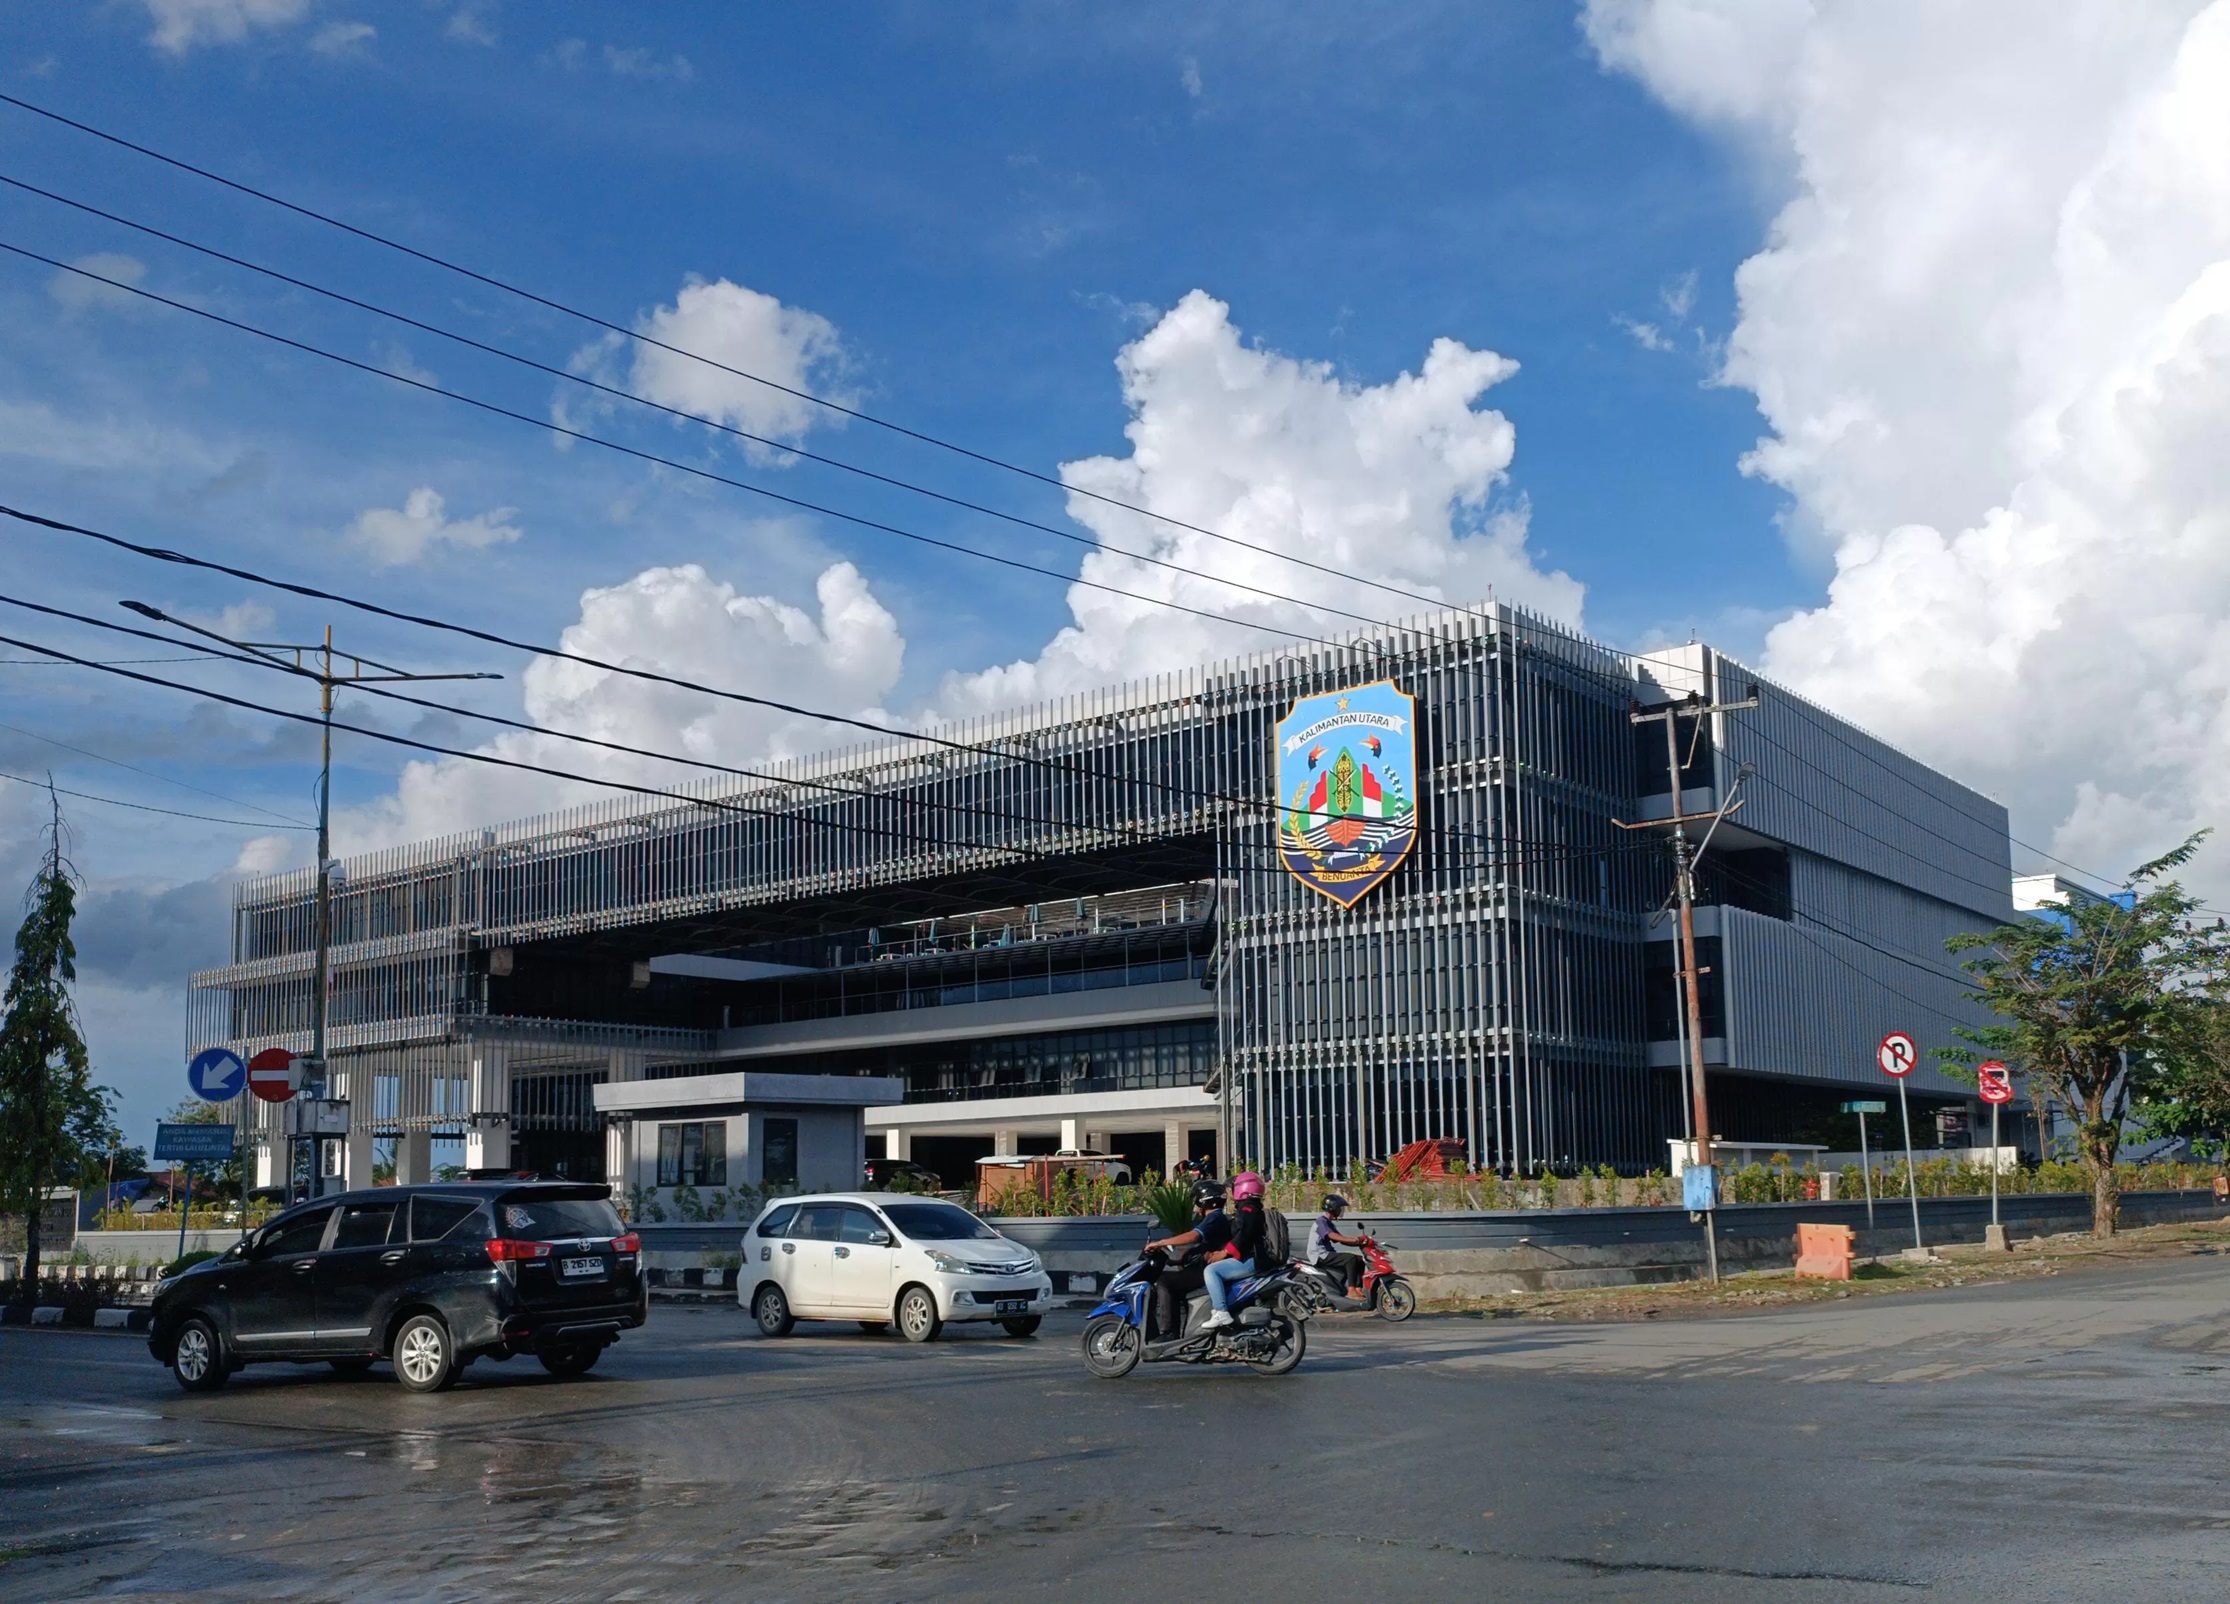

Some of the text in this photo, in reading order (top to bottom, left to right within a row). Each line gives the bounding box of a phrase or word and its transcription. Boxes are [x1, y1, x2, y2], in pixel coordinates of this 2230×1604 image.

[1299, 713, 1389, 744] KALIMANTAN UTARA
[158, 1144, 184, 1152] TERTIB
[562, 1260, 569, 1270] B
